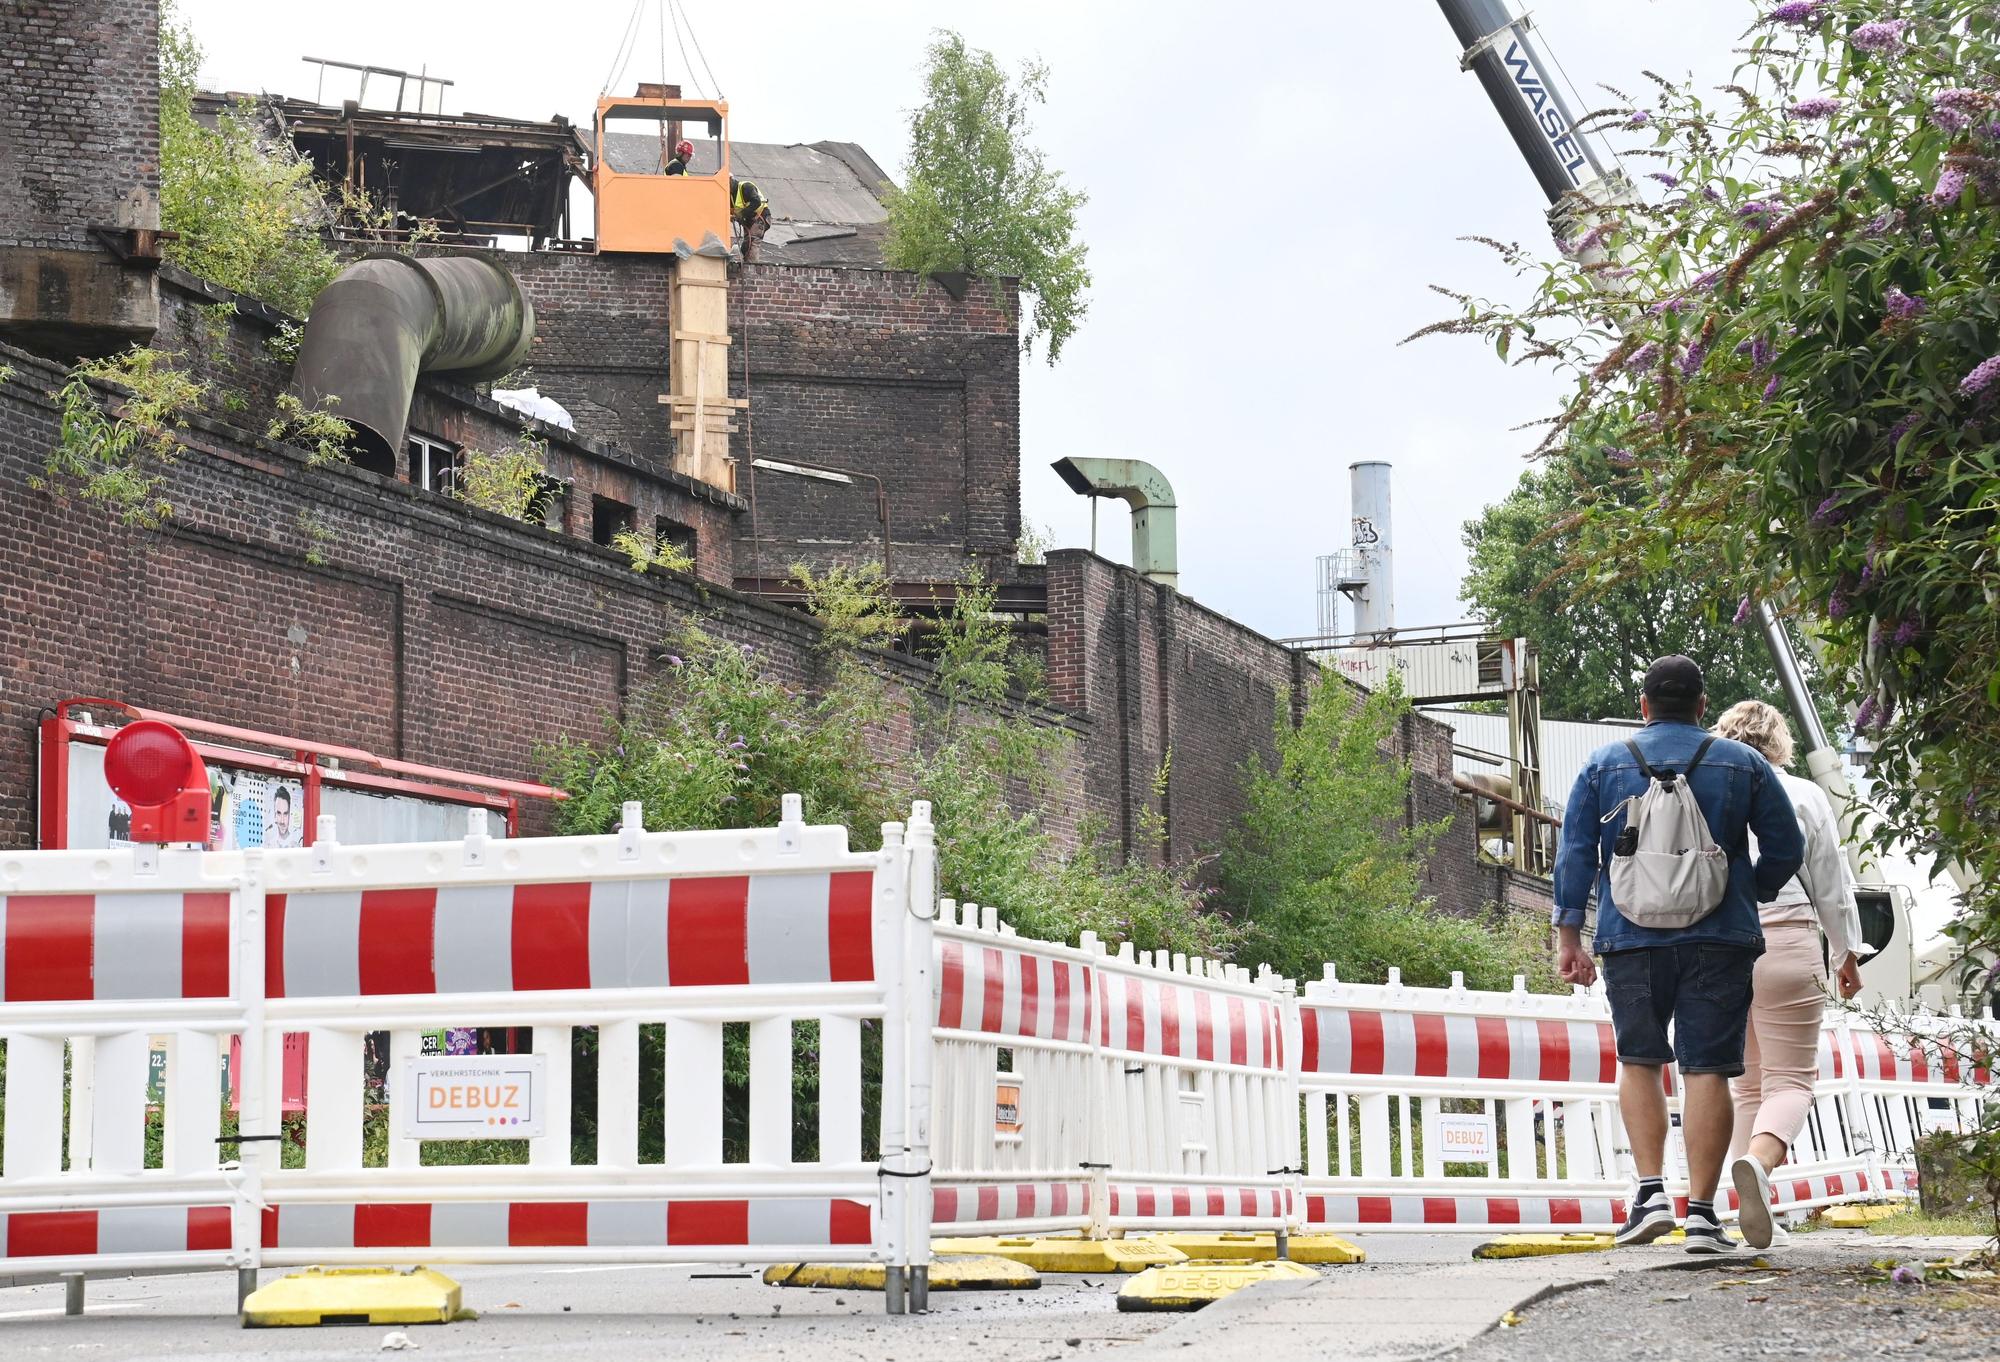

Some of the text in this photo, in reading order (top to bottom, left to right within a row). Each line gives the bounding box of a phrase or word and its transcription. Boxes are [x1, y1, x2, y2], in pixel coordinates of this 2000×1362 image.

[1504, 40, 1585, 186] WASEL
[233, 792, 241, 800] SEE
[233, 801, 241, 809] THE
[232, 809, 247, 817] SOUND
[429, 1085, 519, 1109] DEBUZ
[1446, 1131, 1484, 1144] DEBUZ
